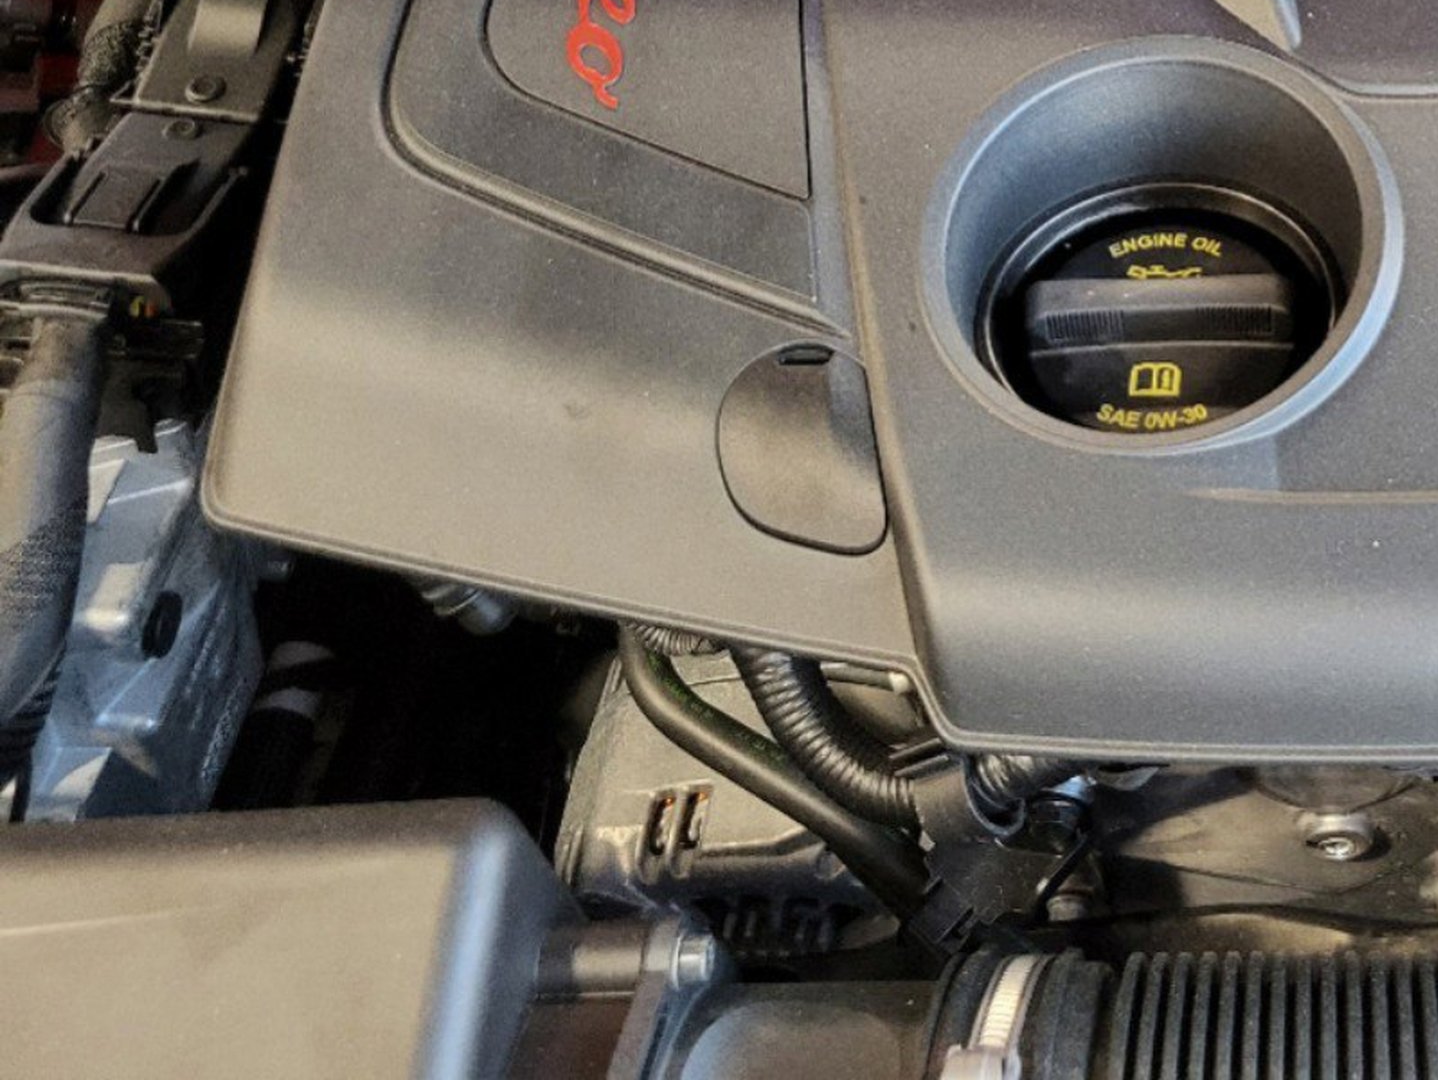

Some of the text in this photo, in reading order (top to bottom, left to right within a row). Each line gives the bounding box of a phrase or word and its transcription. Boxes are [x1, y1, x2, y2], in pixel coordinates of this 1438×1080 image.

[1109, 233, 1222, 258] ENGINE OIL
[1097, 403, 1208, 430] SAE 0W-30
